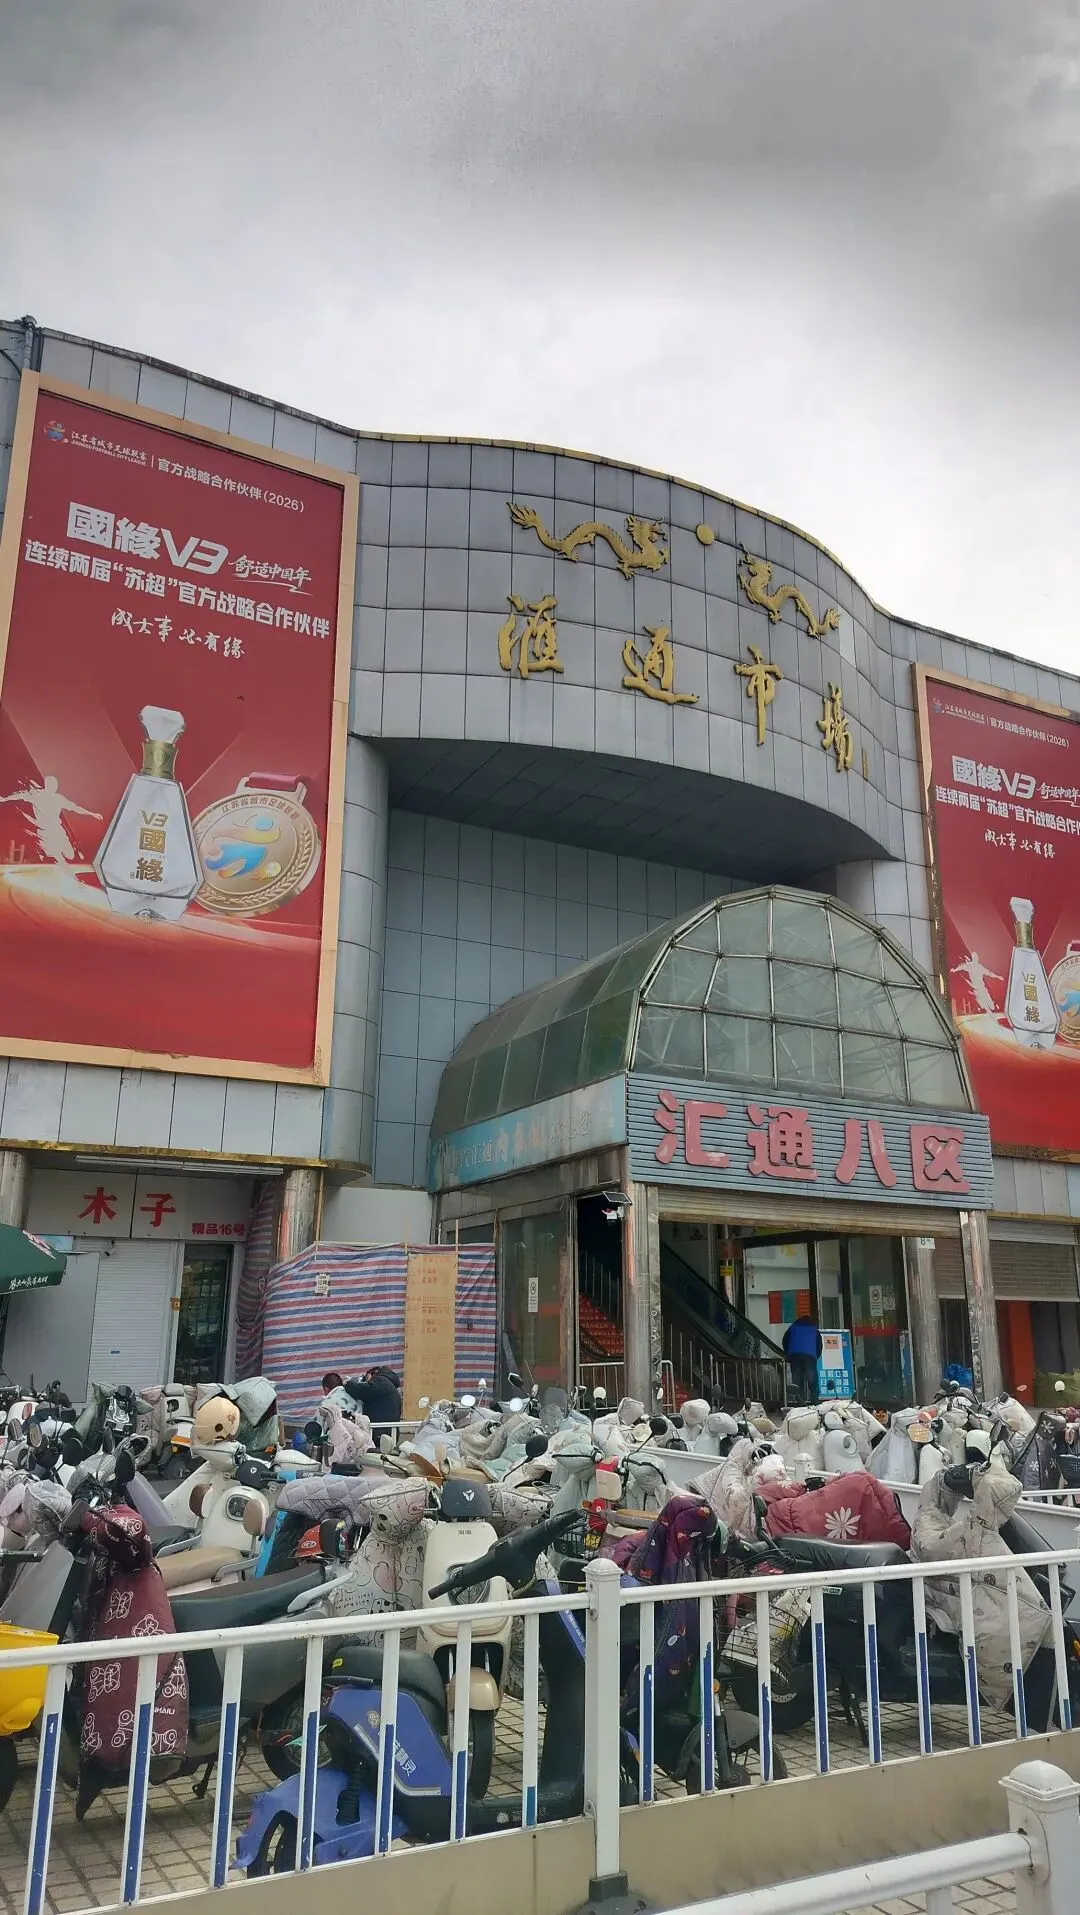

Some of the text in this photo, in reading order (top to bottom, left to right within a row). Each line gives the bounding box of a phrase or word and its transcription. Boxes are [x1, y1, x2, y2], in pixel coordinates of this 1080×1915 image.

[24, 539, 331, 639] 连续两届“苏超”官方战略合作伙伴
[141, 810, 169, 827] V3
[654, 1089, 972, 1194] 汇通八区
[78, 1186, 177, 1228] 木子
[191, 1222, 246, 1236] 精品16号
